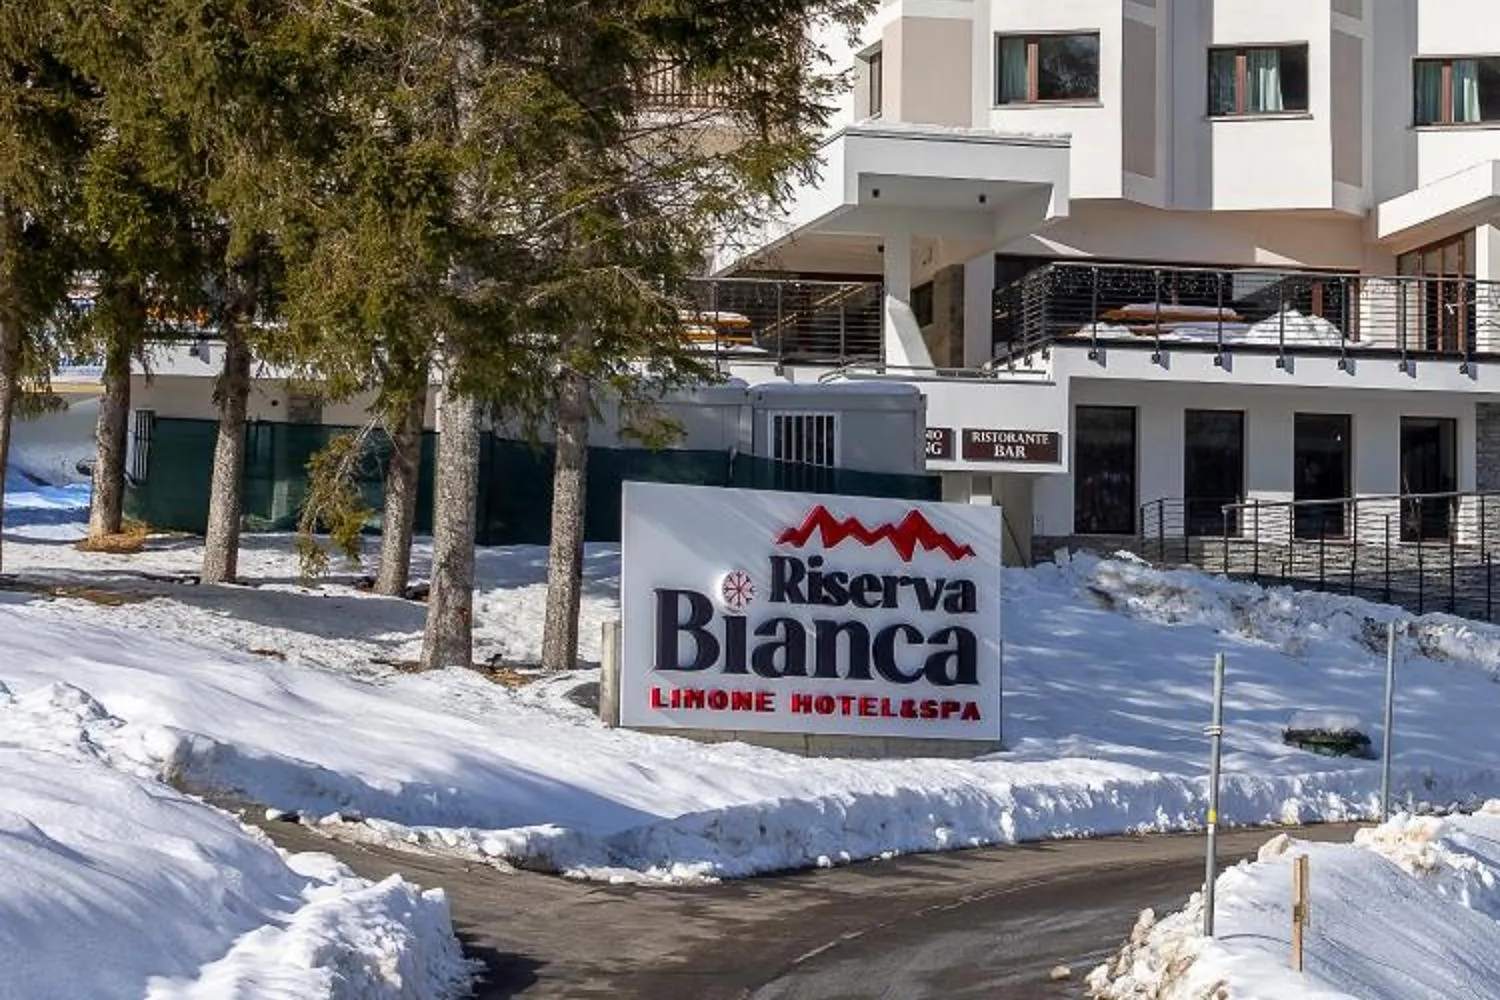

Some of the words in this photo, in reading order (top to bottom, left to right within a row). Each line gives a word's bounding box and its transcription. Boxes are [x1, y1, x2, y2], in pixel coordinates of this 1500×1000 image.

[971, 431, 1050, 445] RISTORANTE
[993, 444, 1026, 459] BAR
[768, 554, 978, 614] Riserva
[652, 587, 980, 686] Bianca
[650, 686, 777, 713] LIMONE
[790, 693, 982, 721] HOTEL&SPA
